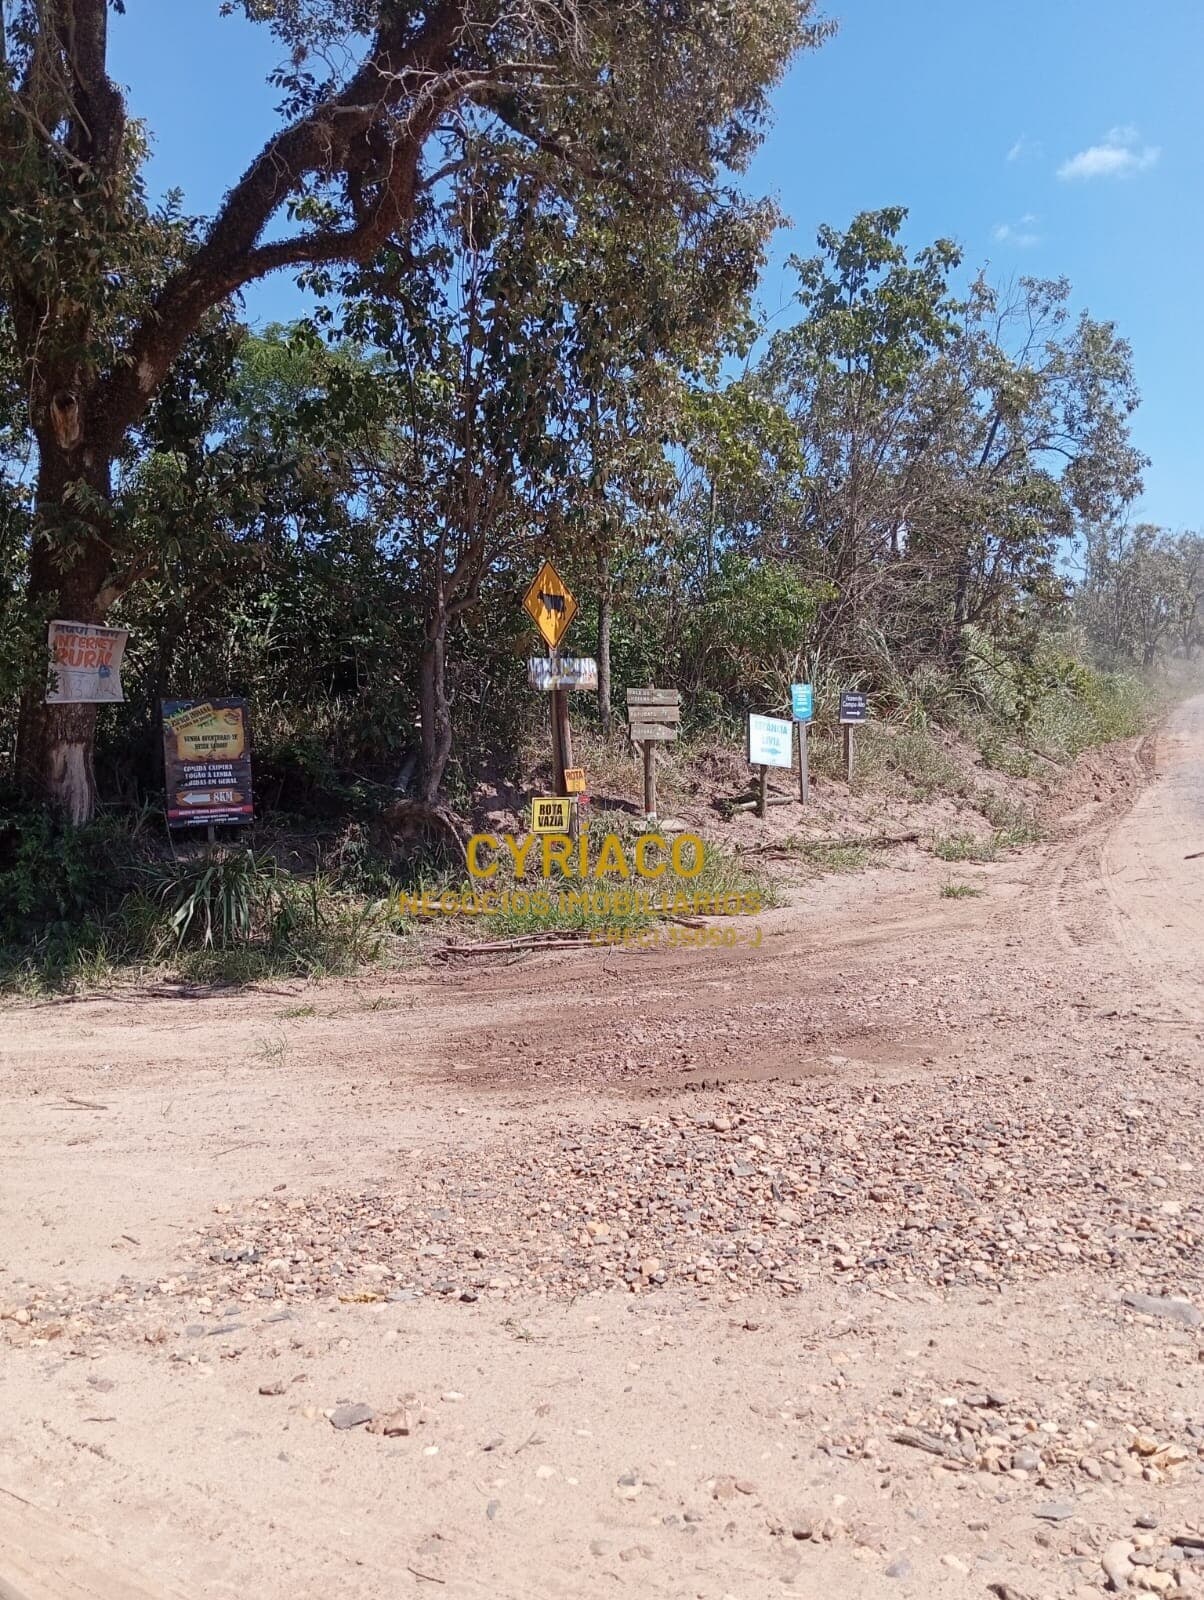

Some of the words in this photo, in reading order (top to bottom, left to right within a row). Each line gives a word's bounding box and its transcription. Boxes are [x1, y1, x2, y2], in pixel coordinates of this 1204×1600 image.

[54, 634, 118, 650] INTERNET
[55, 648, 113, 668] RURAL
[183, 765, 206, 773] COMIDA
[208, 763, 232, 771] CAIPIRA
[213, 791, 233, 802] 8KM
[540, 804, 563, 816] ROTA
[538, 816, 564, 827] VAZIA
